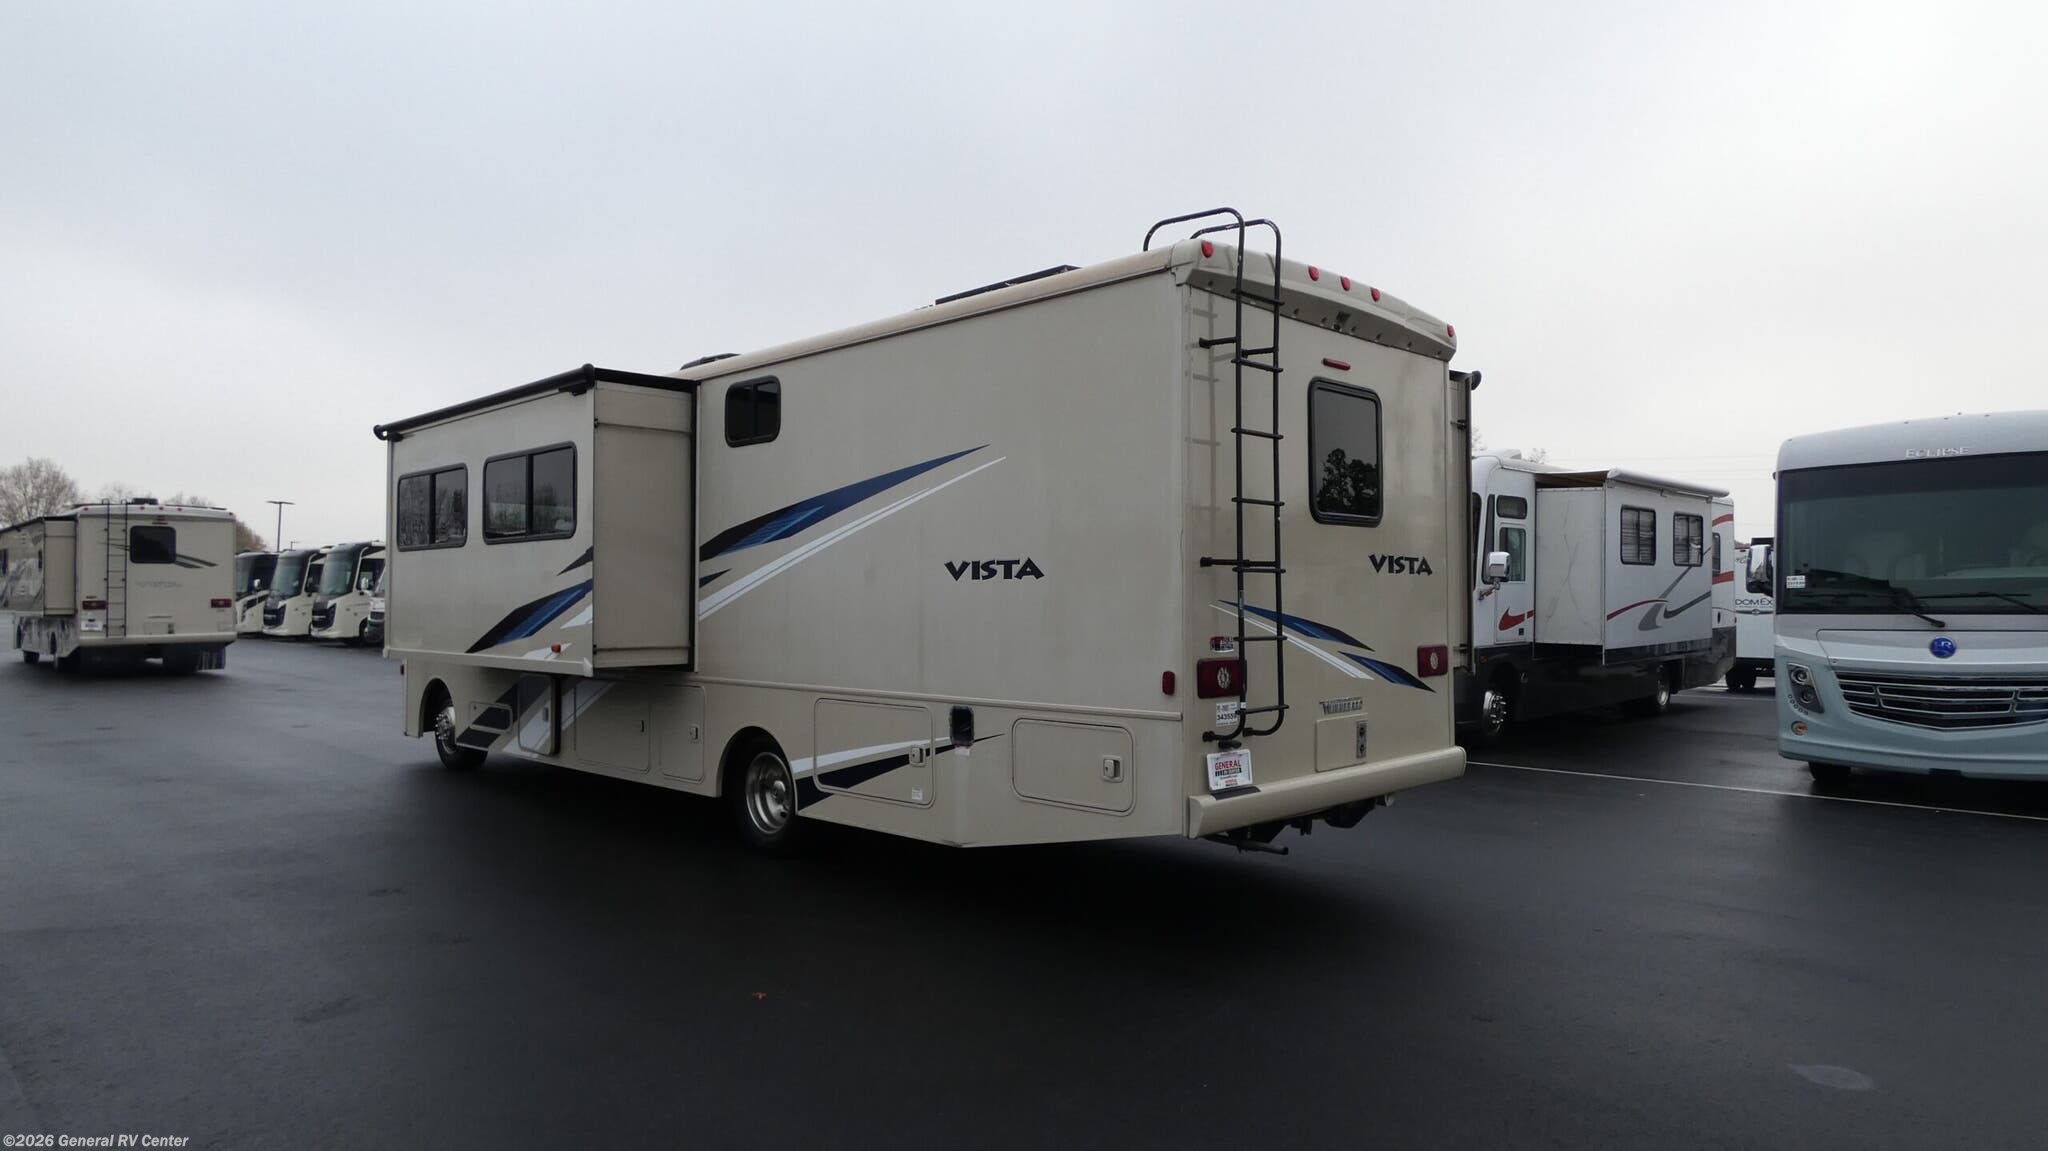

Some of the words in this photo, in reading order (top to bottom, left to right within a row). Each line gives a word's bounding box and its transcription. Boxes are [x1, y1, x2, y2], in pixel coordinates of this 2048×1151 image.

[1905, 447, 1969, 458] ECLIPSE
[944, 557, 1045, 581] VISTA
[1368, 554, 1433, 576] VISTA
[1215, 760, 1242, 770] GENERAL
